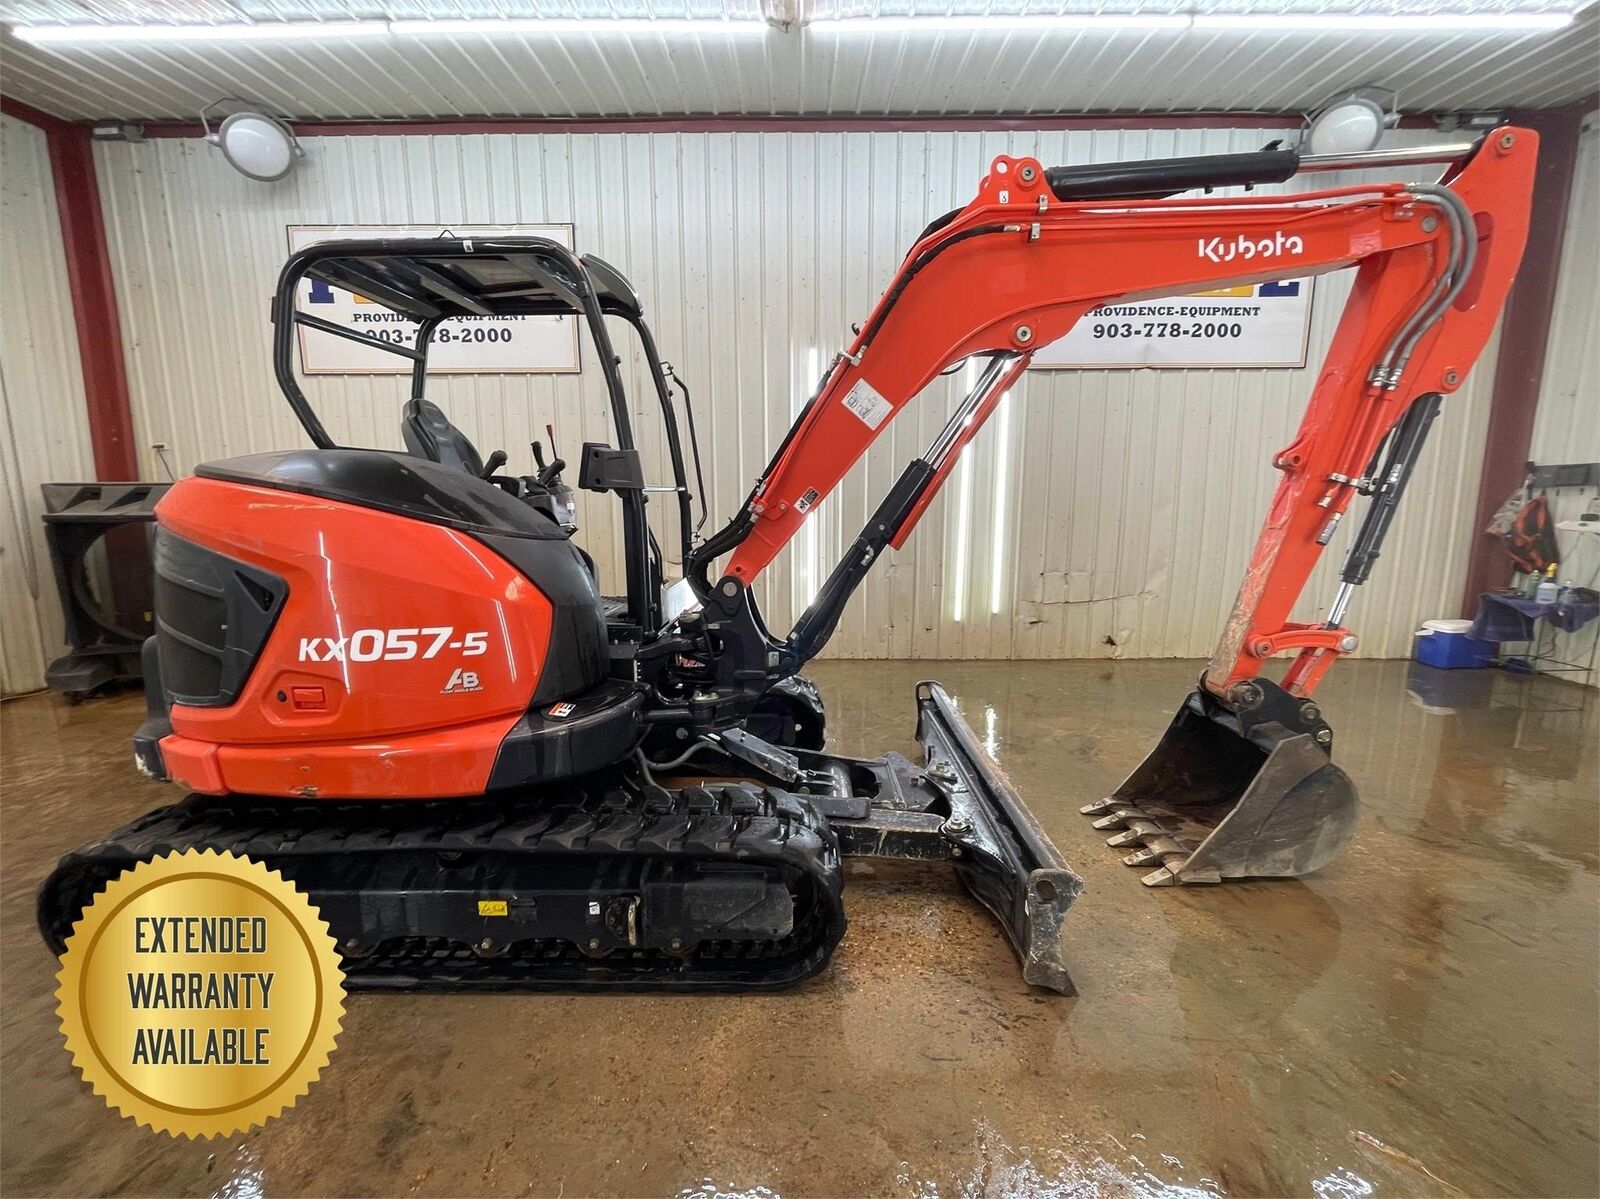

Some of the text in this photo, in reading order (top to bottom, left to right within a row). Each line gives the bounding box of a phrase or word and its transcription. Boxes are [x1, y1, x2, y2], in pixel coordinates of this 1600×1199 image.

[1199, 231, 1303, 263] Kubota
[1093, 323, 1242, 339] 903-778-2000
[298, 626, 488, 663] KX057-5
